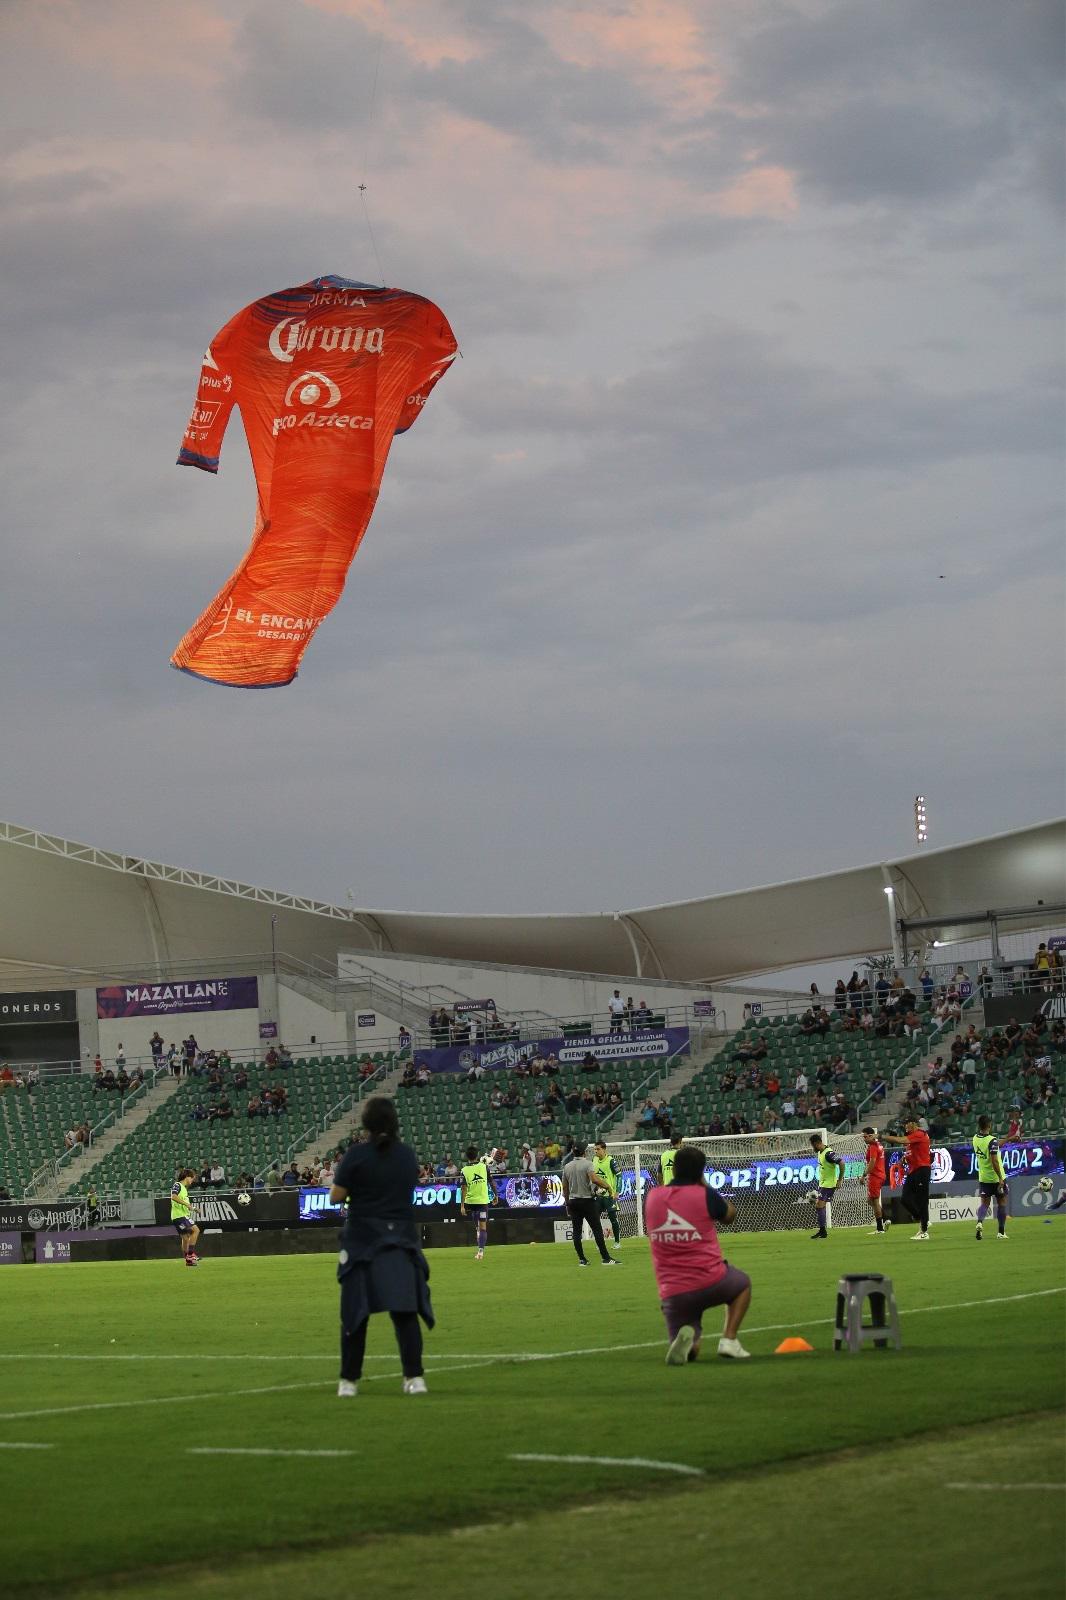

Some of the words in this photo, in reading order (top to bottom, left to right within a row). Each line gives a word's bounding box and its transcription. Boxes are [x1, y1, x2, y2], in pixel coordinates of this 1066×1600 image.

[298, 411, 374, 430] Azteca
[235, 608, 255, 624] EL
[260, 613, 325, 630] ENCAN
[257, 629, 308, 641] DESARR
[564, 1039, 596, 1047] TIENDA
[598, 1034, 633, 1044] OFICIAL
[1030, 1147, 1043, 1168] 2
[729, 1169, 752, 1188] 12
[939, 1207, 974, 1220] BBVA
[650, 1231, 703, 1243] PIRMA
